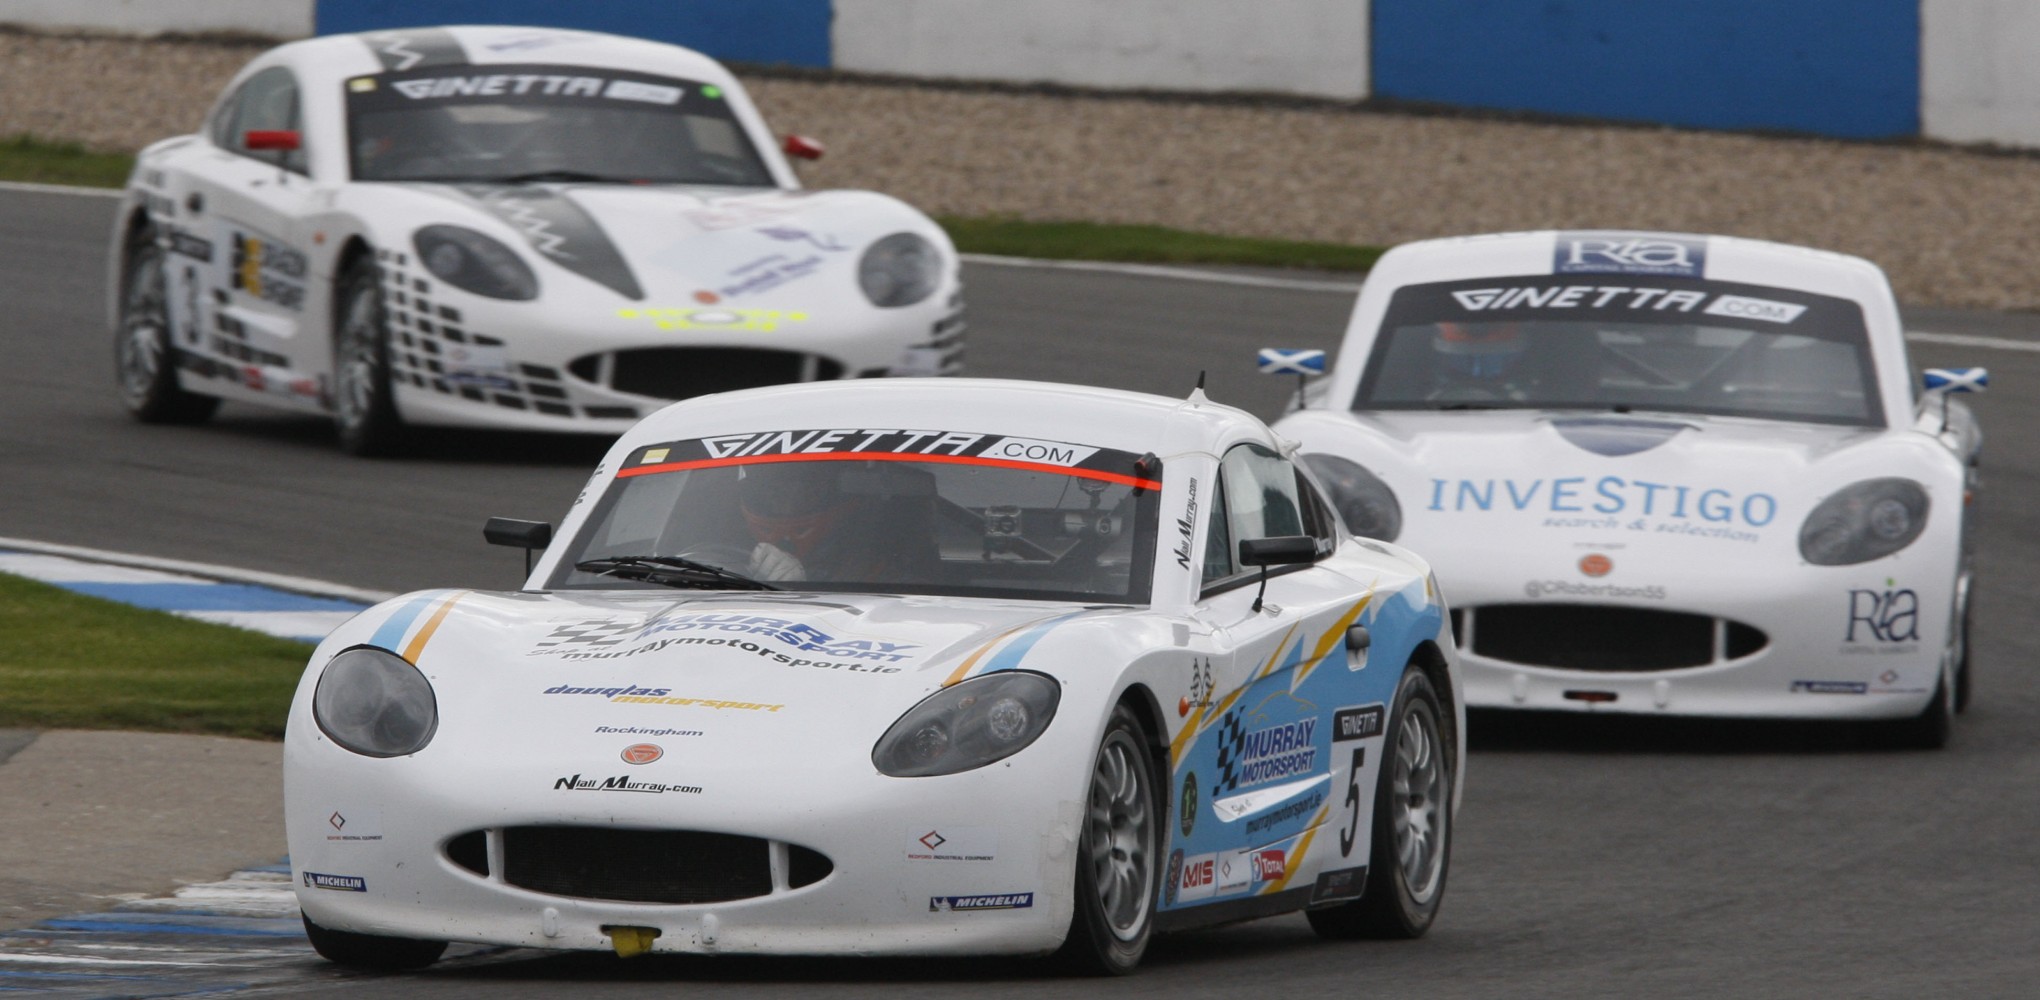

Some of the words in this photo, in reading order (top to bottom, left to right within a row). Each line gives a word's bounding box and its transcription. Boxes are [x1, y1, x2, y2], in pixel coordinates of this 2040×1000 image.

[391, 74, 603, 100] GINETTA
[1451, 286, 1706, 311] GINETTA
[702, 430, 981, 459] GINETTA
[993, 441, 1075, 465] .COM
[1427, 475, 1778, 528] INVESTIGO
[1541, 514, 1619, 531] search
[1626, 518, 1648, 531] &
[1655, 521, 1760, 543] selection
[1524, 579, 1667, 601] @CRobertson55
[1845, 577, 1920, 643] Ria
[631, 622, 914, 664] MOTORSPORT
[651, 613, 922, 653] MURRAY
[560, 637, 903, 675] murraymotorsport.ie
[543, 684, 673, 699] douglas
[611, 693, 786, 713] motorsport
[594, 725, 704, 738] Rockingham
[1341, 711, 1378, 736] GINETTA
[1243, 716, 1319, 762] MURRAY
[1239, 749, 1316, 788] MOTORSPORT
[1246, 791, 1322, 836] murraymotorsport.ie
[1339, 746, 1367, 859] 5
[1183, 859, 1214, 889] MIS
[1262, 857, 1285, 875] TOTAL
[317, 875, 362, 888] MICHELIN
[956, 894, 1029, 907] MICHELIN
